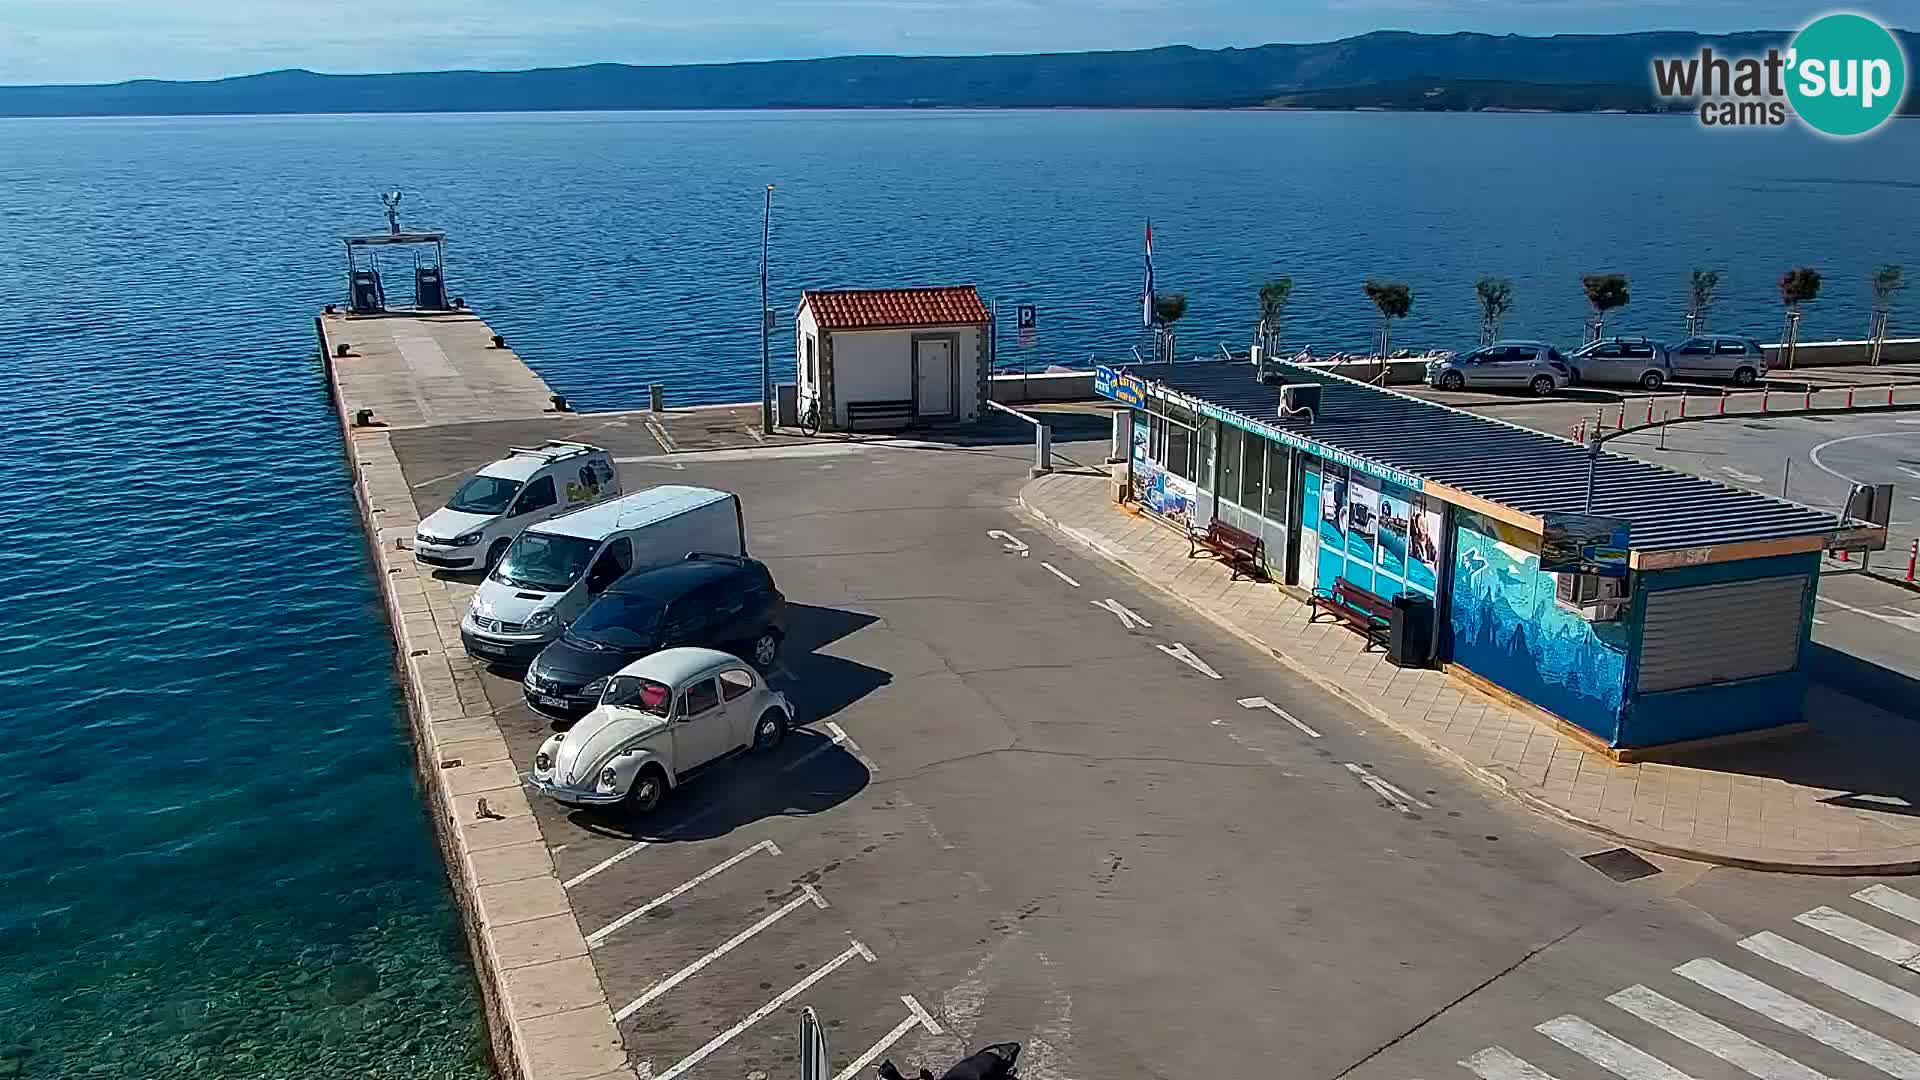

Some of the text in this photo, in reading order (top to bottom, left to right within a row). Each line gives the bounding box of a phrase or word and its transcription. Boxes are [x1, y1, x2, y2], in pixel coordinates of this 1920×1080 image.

[1022, 308, 1032, 325] P
[1319, 448, 1334, 460] BUS
[1335, 453, 1364, 470] STATION
[1367, 464, 1391, 478] TICKET
[1392, 473, 1419, 488] OFFICE
